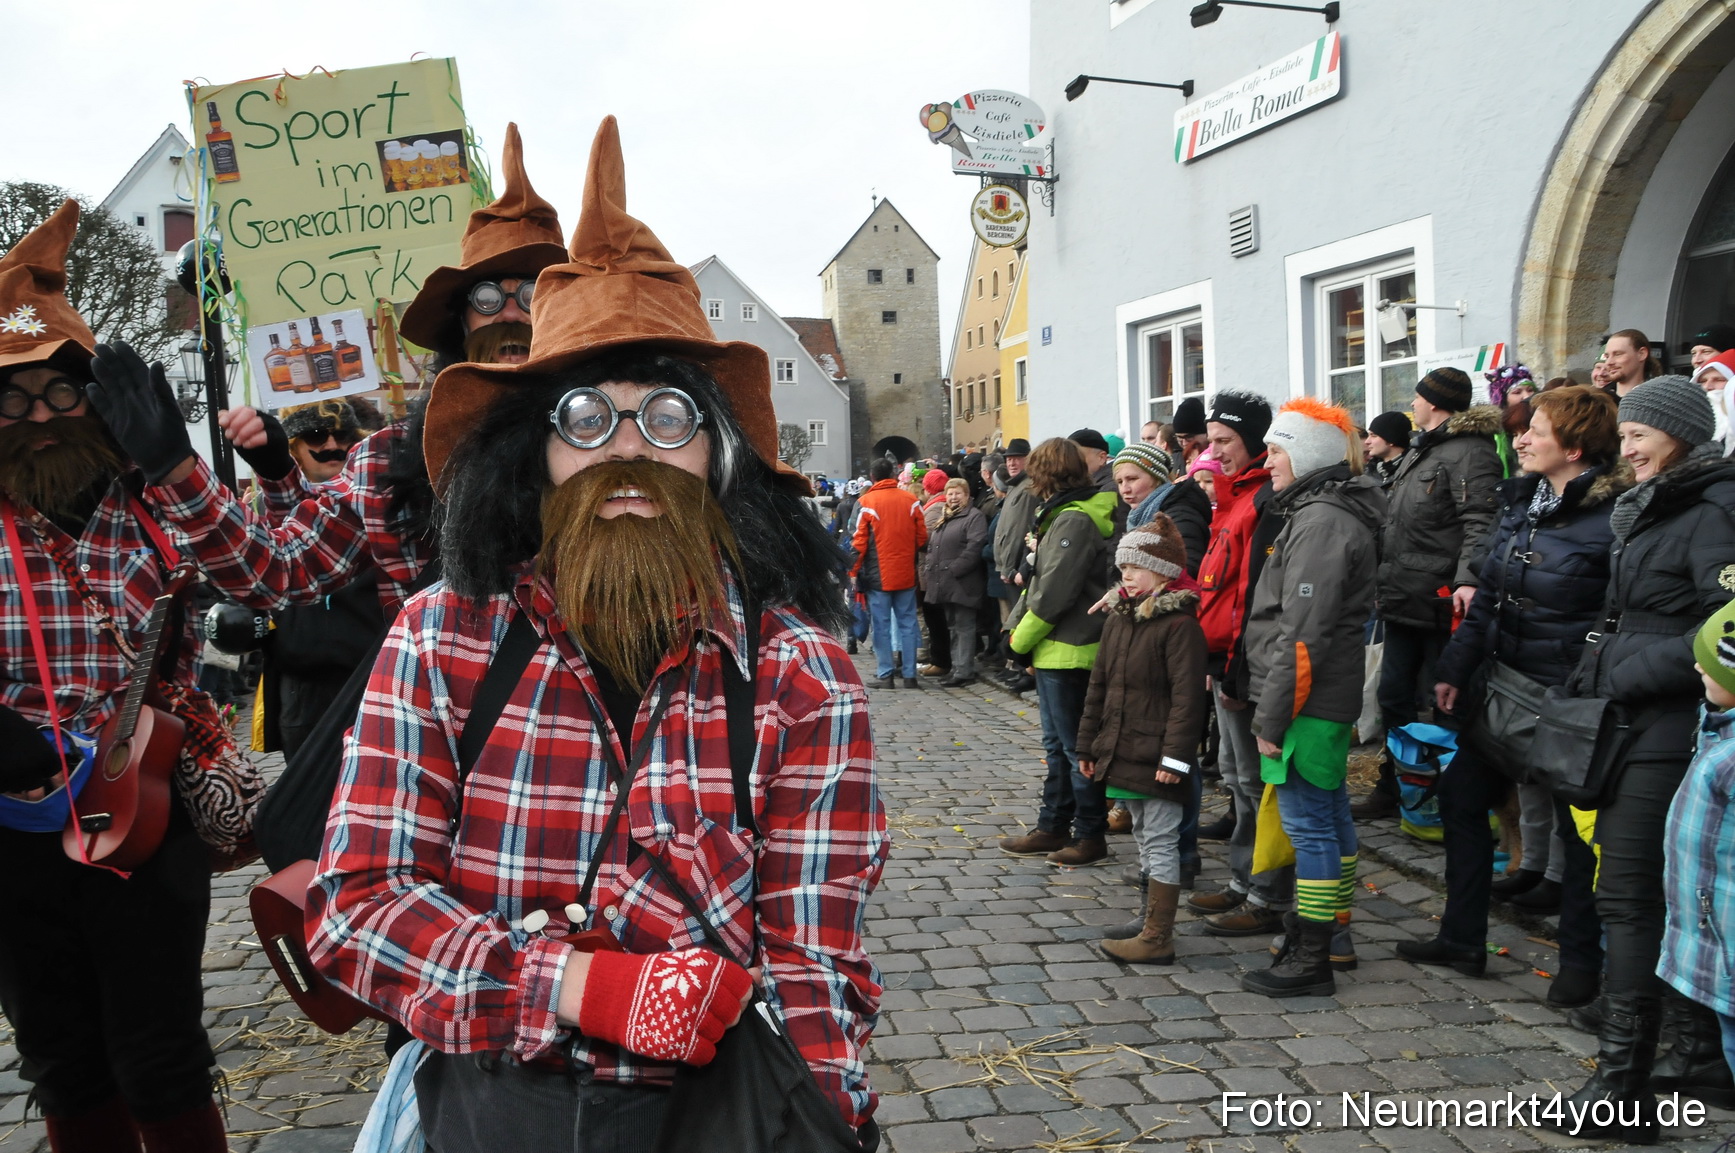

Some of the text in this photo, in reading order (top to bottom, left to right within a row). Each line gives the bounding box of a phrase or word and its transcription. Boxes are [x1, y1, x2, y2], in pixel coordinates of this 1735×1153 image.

[1269, 56, 1304, 80] Eisdiele
[973, 92, 1022, 107] Pizzeria
[235, 80, 411, 166] Sport
[985, 111, 1012, 123] Café
[1199, 84, 1305, 147] Bella Roma
[972, 125, 1024, 141] Eisdiele
[957, 159, 996, 168] Roma
[982, 152, 1017, 162] Bella
[315, 159, 373, 188] im
[228, 187, 454, 250] Generationen
[276, 249, 420, 313] Park
